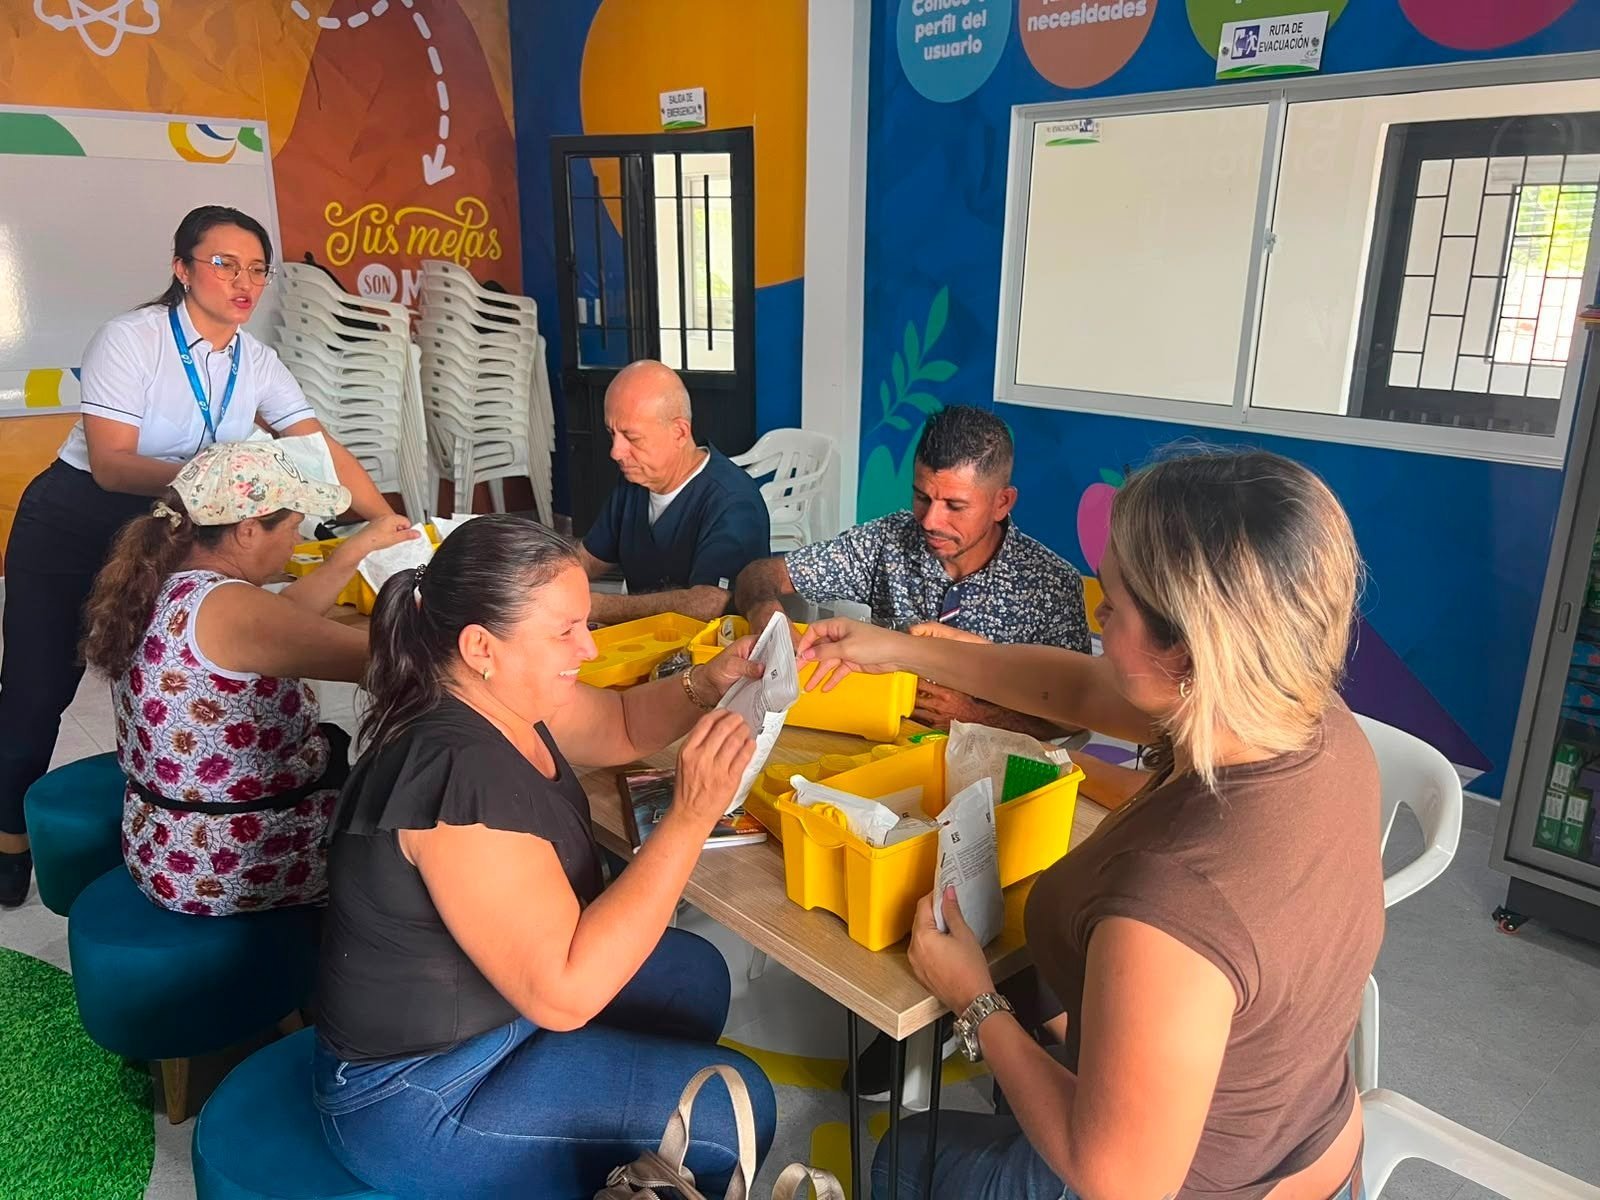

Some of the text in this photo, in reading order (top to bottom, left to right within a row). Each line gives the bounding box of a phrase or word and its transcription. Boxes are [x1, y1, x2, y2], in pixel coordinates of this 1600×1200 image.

[915, 9, 987, 43] perfil del
[1027, 0, 1147, 32] necesidades
[1269, 21, 1303, 36] RUTA DE
[924, 34, 983, 60] usuario
[1258, 35, 1310, 53] EVACUACIÓN
[325, 196, 502, 269] Tus metas
[364, 275, 391, 295] SON
